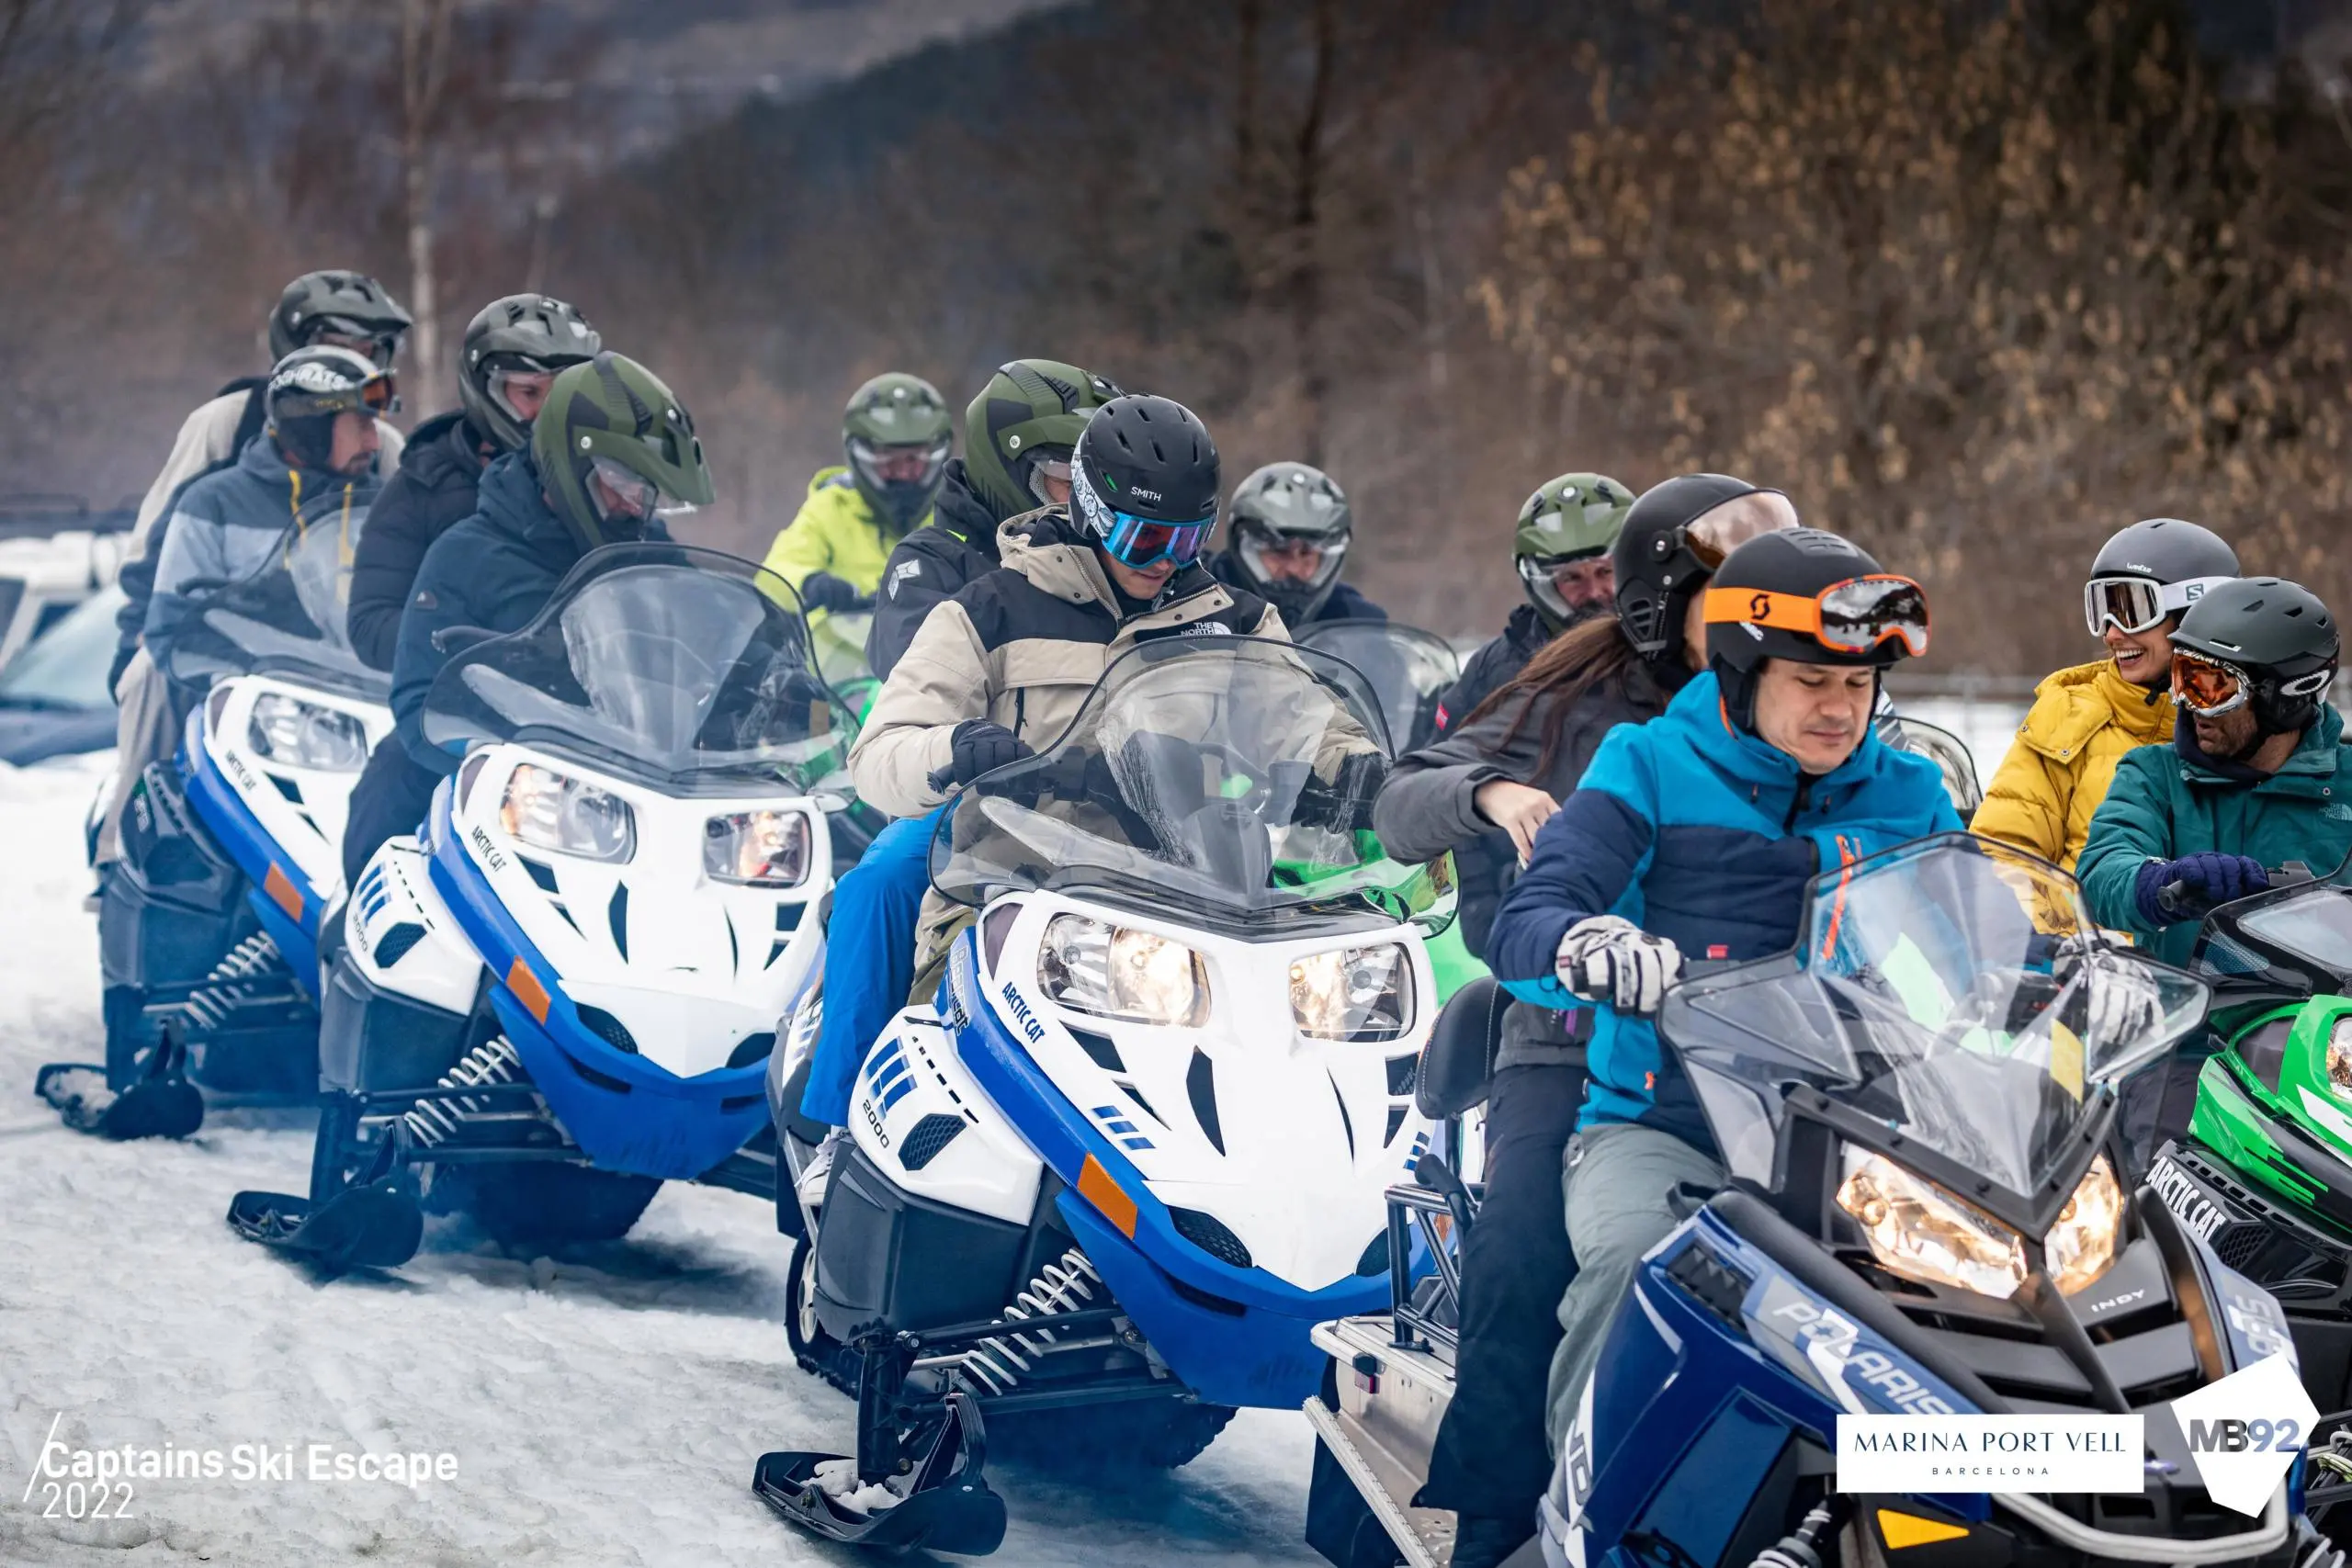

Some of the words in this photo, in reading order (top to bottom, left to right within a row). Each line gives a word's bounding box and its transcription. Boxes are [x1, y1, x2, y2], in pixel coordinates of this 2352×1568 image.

[1130, 486, 1162, 502] SMITH
[1181, 628, 1215, 637] NORTH
[225, 749, 246, 780] ARCTIC
[242, 773, 257, 791] CAT
[471, 825, 495, 859] ARCTIC
[489, 852, 507, 873] CAT
[1002, 981, 1032, 1025] ARCTIC
[1024, 1018, 1046, 1044] CAT
[863, 1099, 890, 1148] 2000
[2145, 1156, 2200, 1216] ARCTIC
[2188, 1200, 2227, 1243] CAT
[2091, 1289, 2145, 1313] INDY
